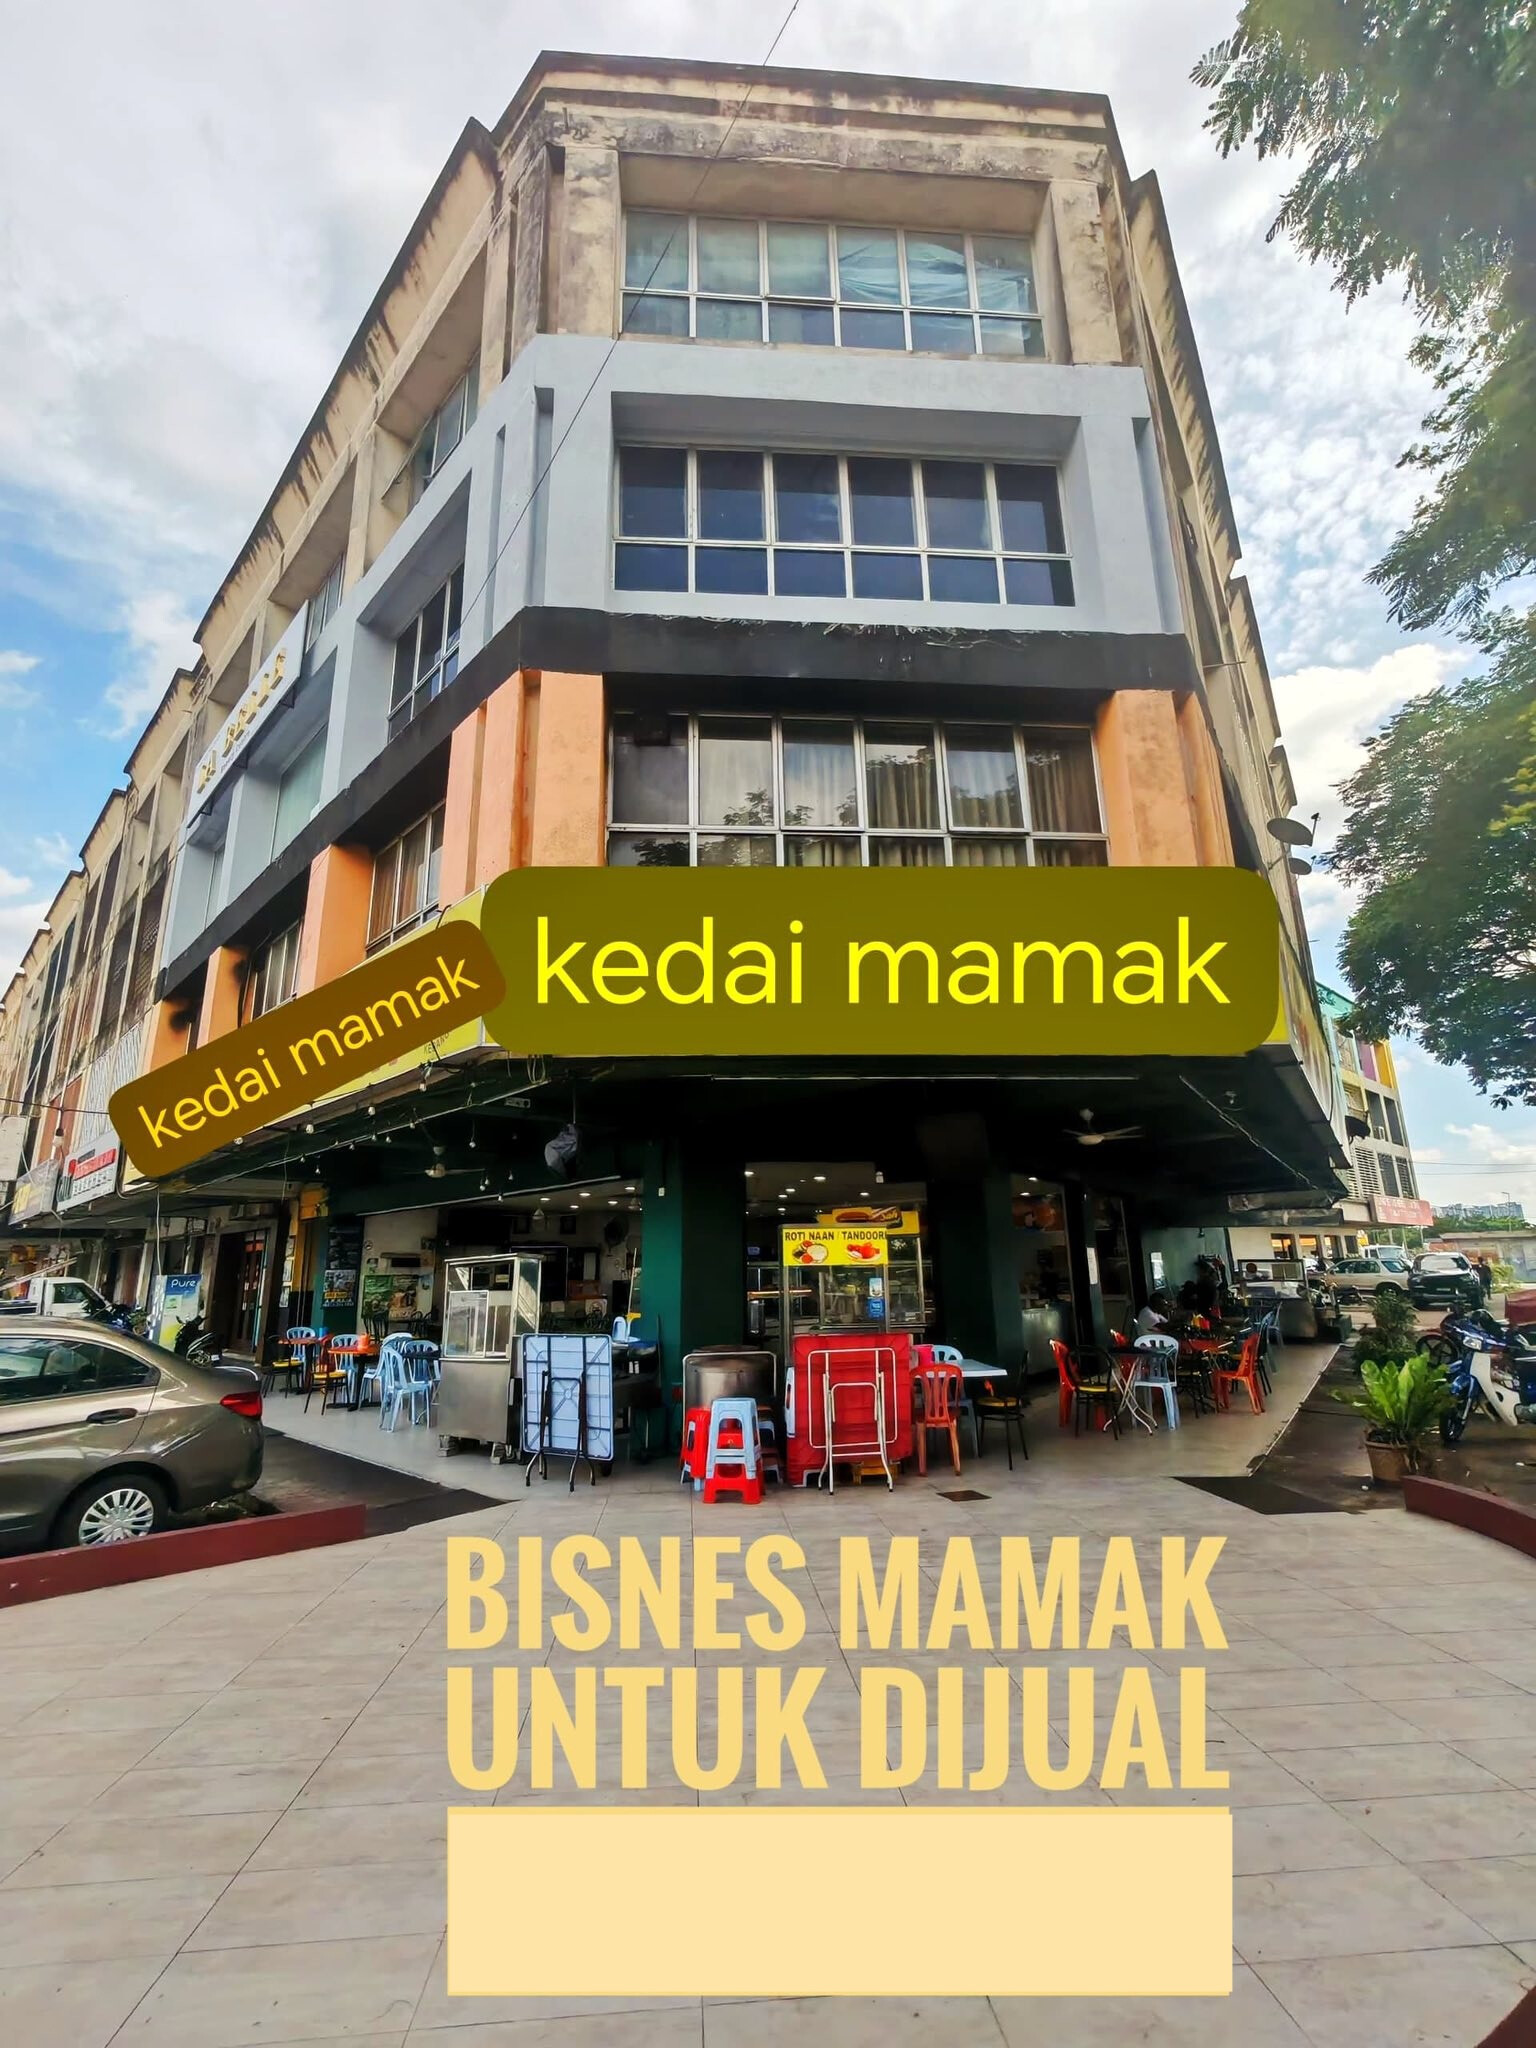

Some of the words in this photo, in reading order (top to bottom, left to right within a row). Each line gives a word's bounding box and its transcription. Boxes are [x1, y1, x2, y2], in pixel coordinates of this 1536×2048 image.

[785, 1231, 806, 1241] ROTI
[809, 1231, 835, 1240] NAAN
[171, 1279, 196, 1288] Pure
